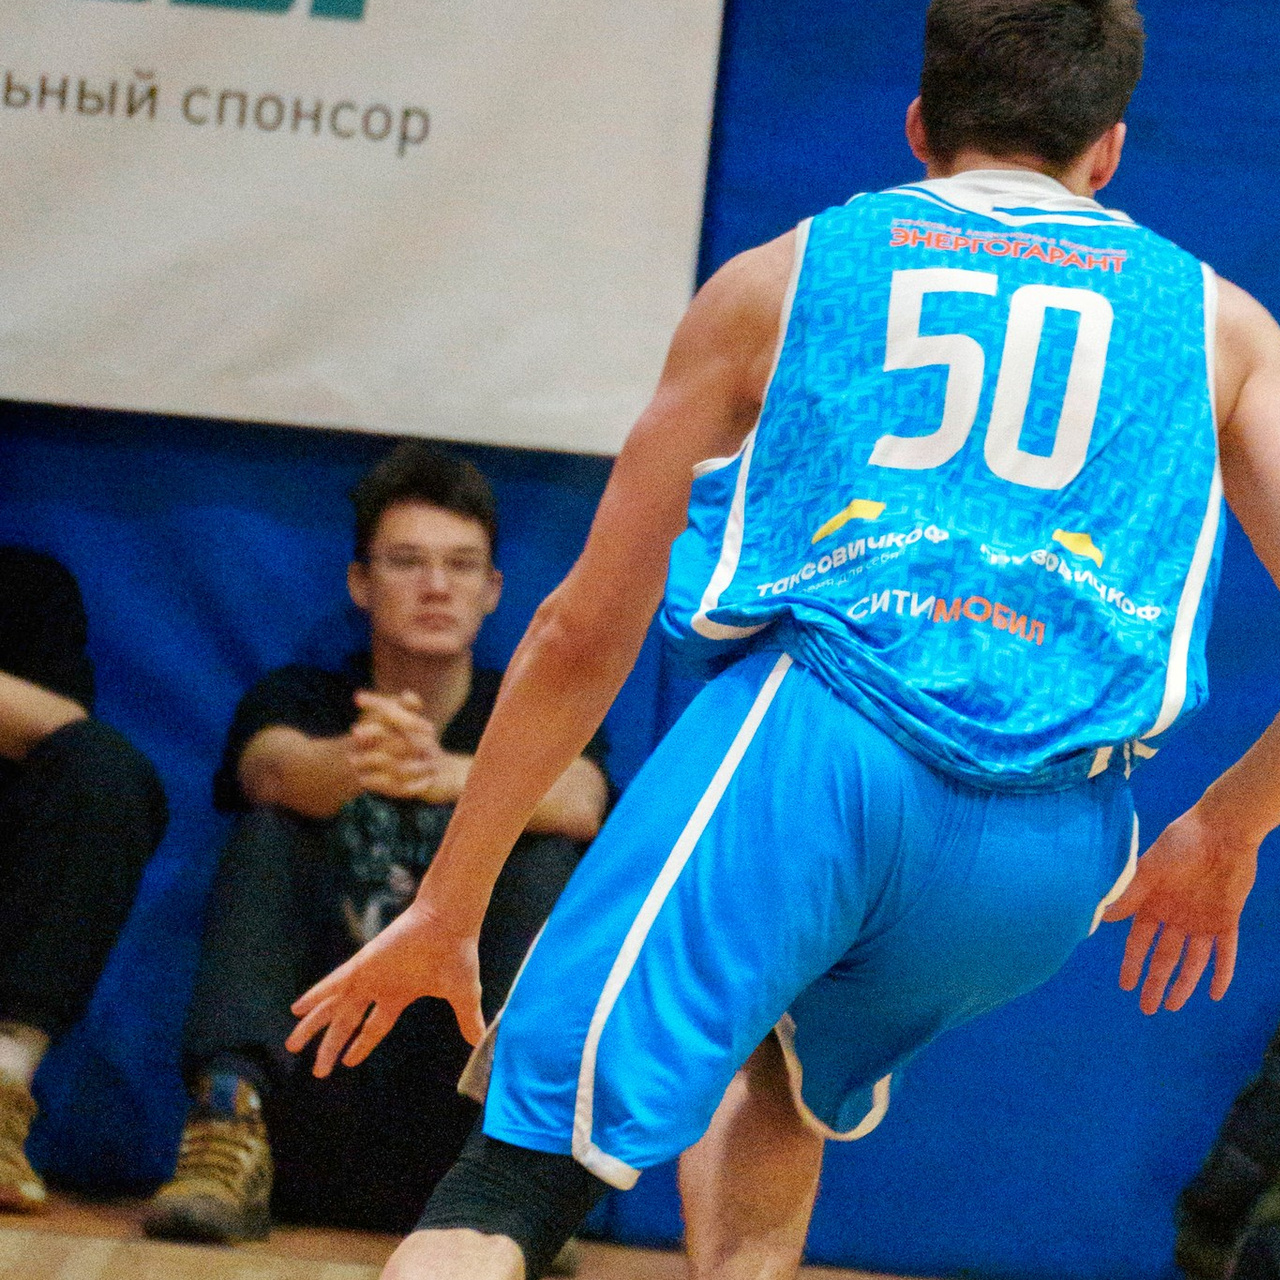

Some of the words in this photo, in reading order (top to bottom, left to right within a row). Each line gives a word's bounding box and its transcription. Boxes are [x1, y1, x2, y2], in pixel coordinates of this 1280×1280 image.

[181, 84, 432, 158] спонсор
[889, 226, 1128, 274] ЭНЕРГОГАРАНТ
[868, 267, 1115, 491] 50
[846, 588, 1046, 646] СИТИМОБИЛ
